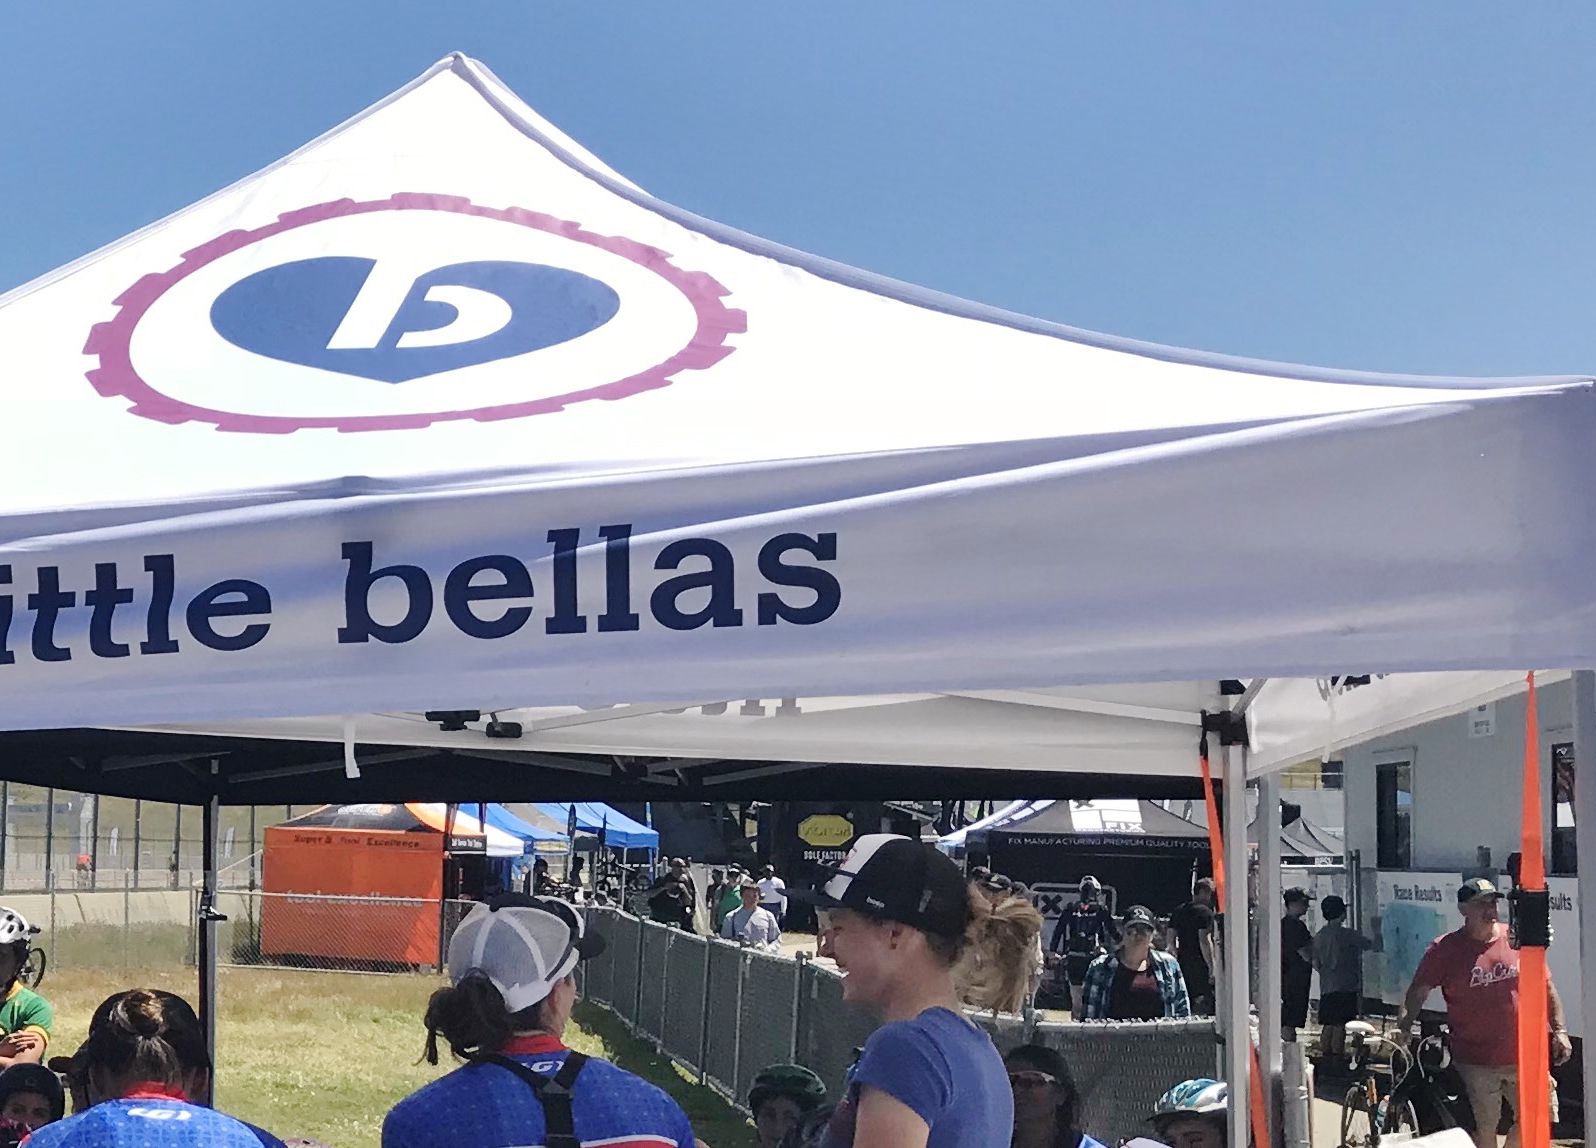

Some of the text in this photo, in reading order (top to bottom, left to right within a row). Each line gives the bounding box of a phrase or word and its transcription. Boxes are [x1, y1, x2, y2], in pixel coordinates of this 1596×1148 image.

[338, 523, 841, 644] bellas
[1105, 822, 1142, 830] FIX
[1024, 838, 1101, 846] MANUFACTURING
[1103, 838, 1144, 846] PREMIUM
[1145, 839, 1185, 848] QUALITY
[1414, 886, 1442, 902] Results
